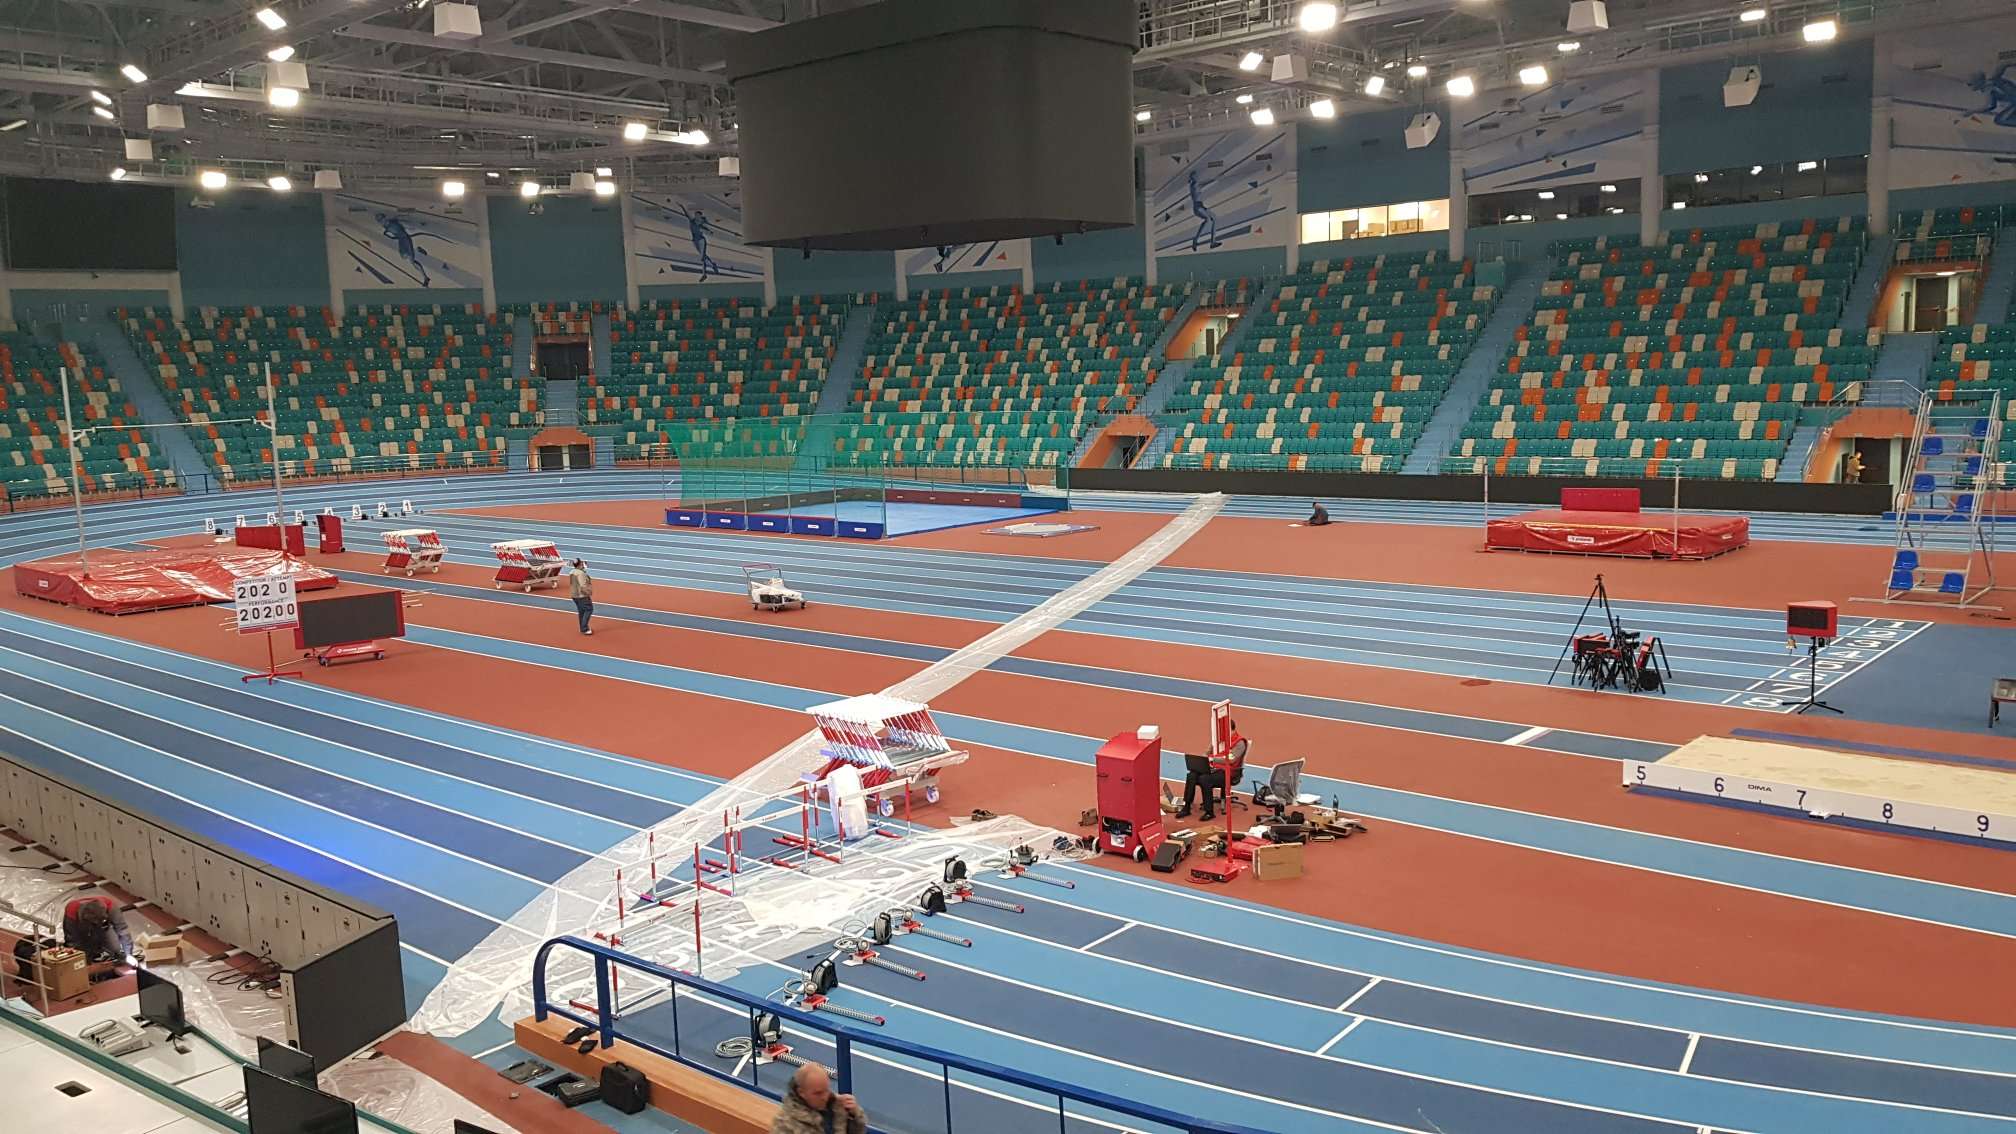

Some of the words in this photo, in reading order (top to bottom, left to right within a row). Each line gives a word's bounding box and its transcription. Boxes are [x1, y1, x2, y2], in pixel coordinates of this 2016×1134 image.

[354, 507, 360, 516] 3
[268, 514, 275, 524] 6
[207, 520, 214, 530] 8
[248, 598, 284, 607] PERFORMANCE
[1883, 621, 1905, 629] 1
[1862, 629, 1898, 639] 2
[1846, 639, 1882, 648] 3
[1828, 650, 1863, 659] 4
[1808, 660, 1847, 670] 5
[1788, 671, 1828, 681] 6
[1769, 682, 1811, 694] 7
[1636, 765, 1647, 781] 5
[1714, 777, 1725, 793] 6
[1747, 783, 1773, 793] DIMA
[1796, 789, 1807, 806] 7
[1882, 802, 1894, 820] 8
[1976, 815, 1990, 832] 9
